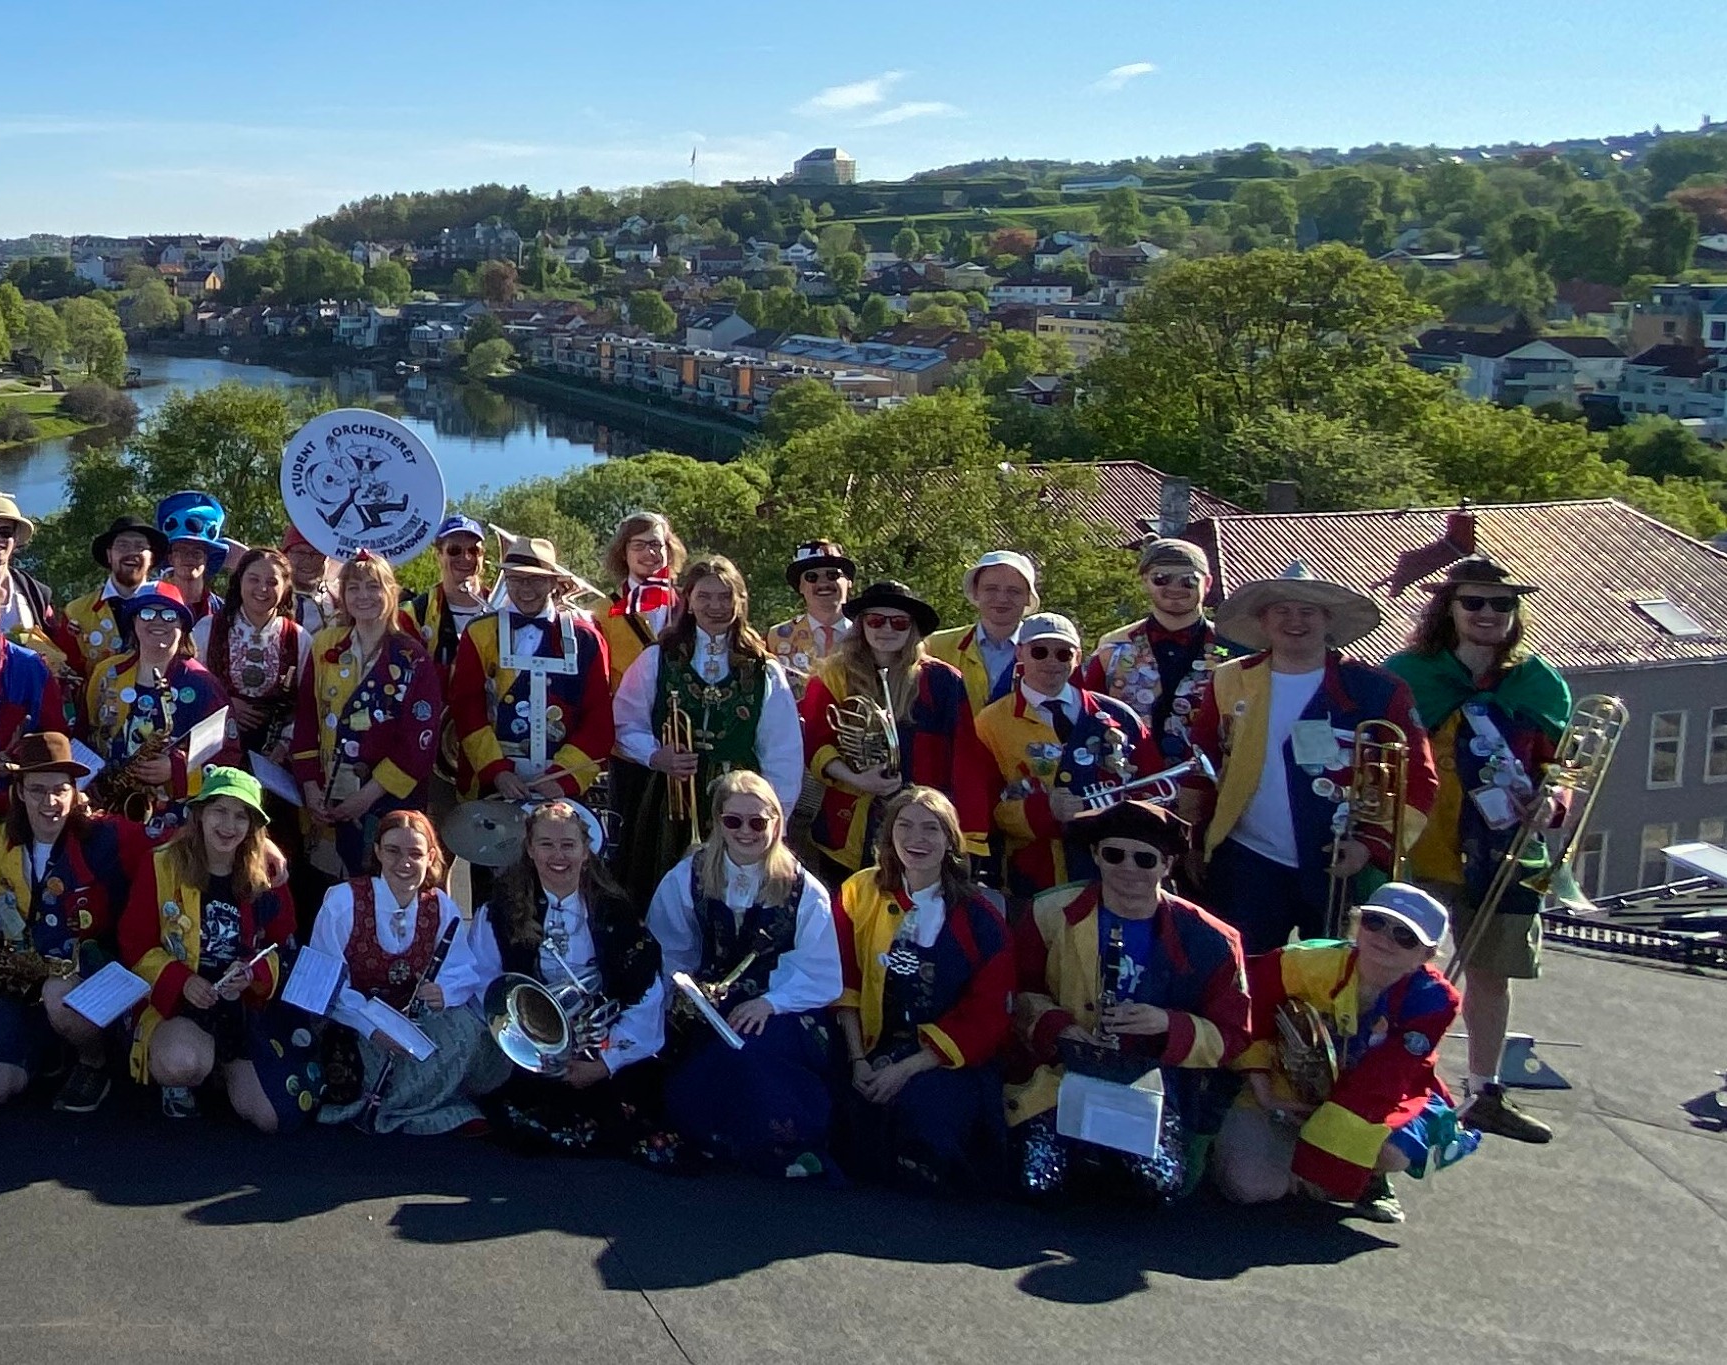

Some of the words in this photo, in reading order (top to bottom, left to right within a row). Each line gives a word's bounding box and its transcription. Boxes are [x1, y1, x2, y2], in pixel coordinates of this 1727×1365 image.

[291, 440, 317, 498] STUDENT
[331, 423, 417, 465] ORCHESTERET
[335, 548, 354, 559] NT
[380, 520, 431, 559] TRONDHEIM
